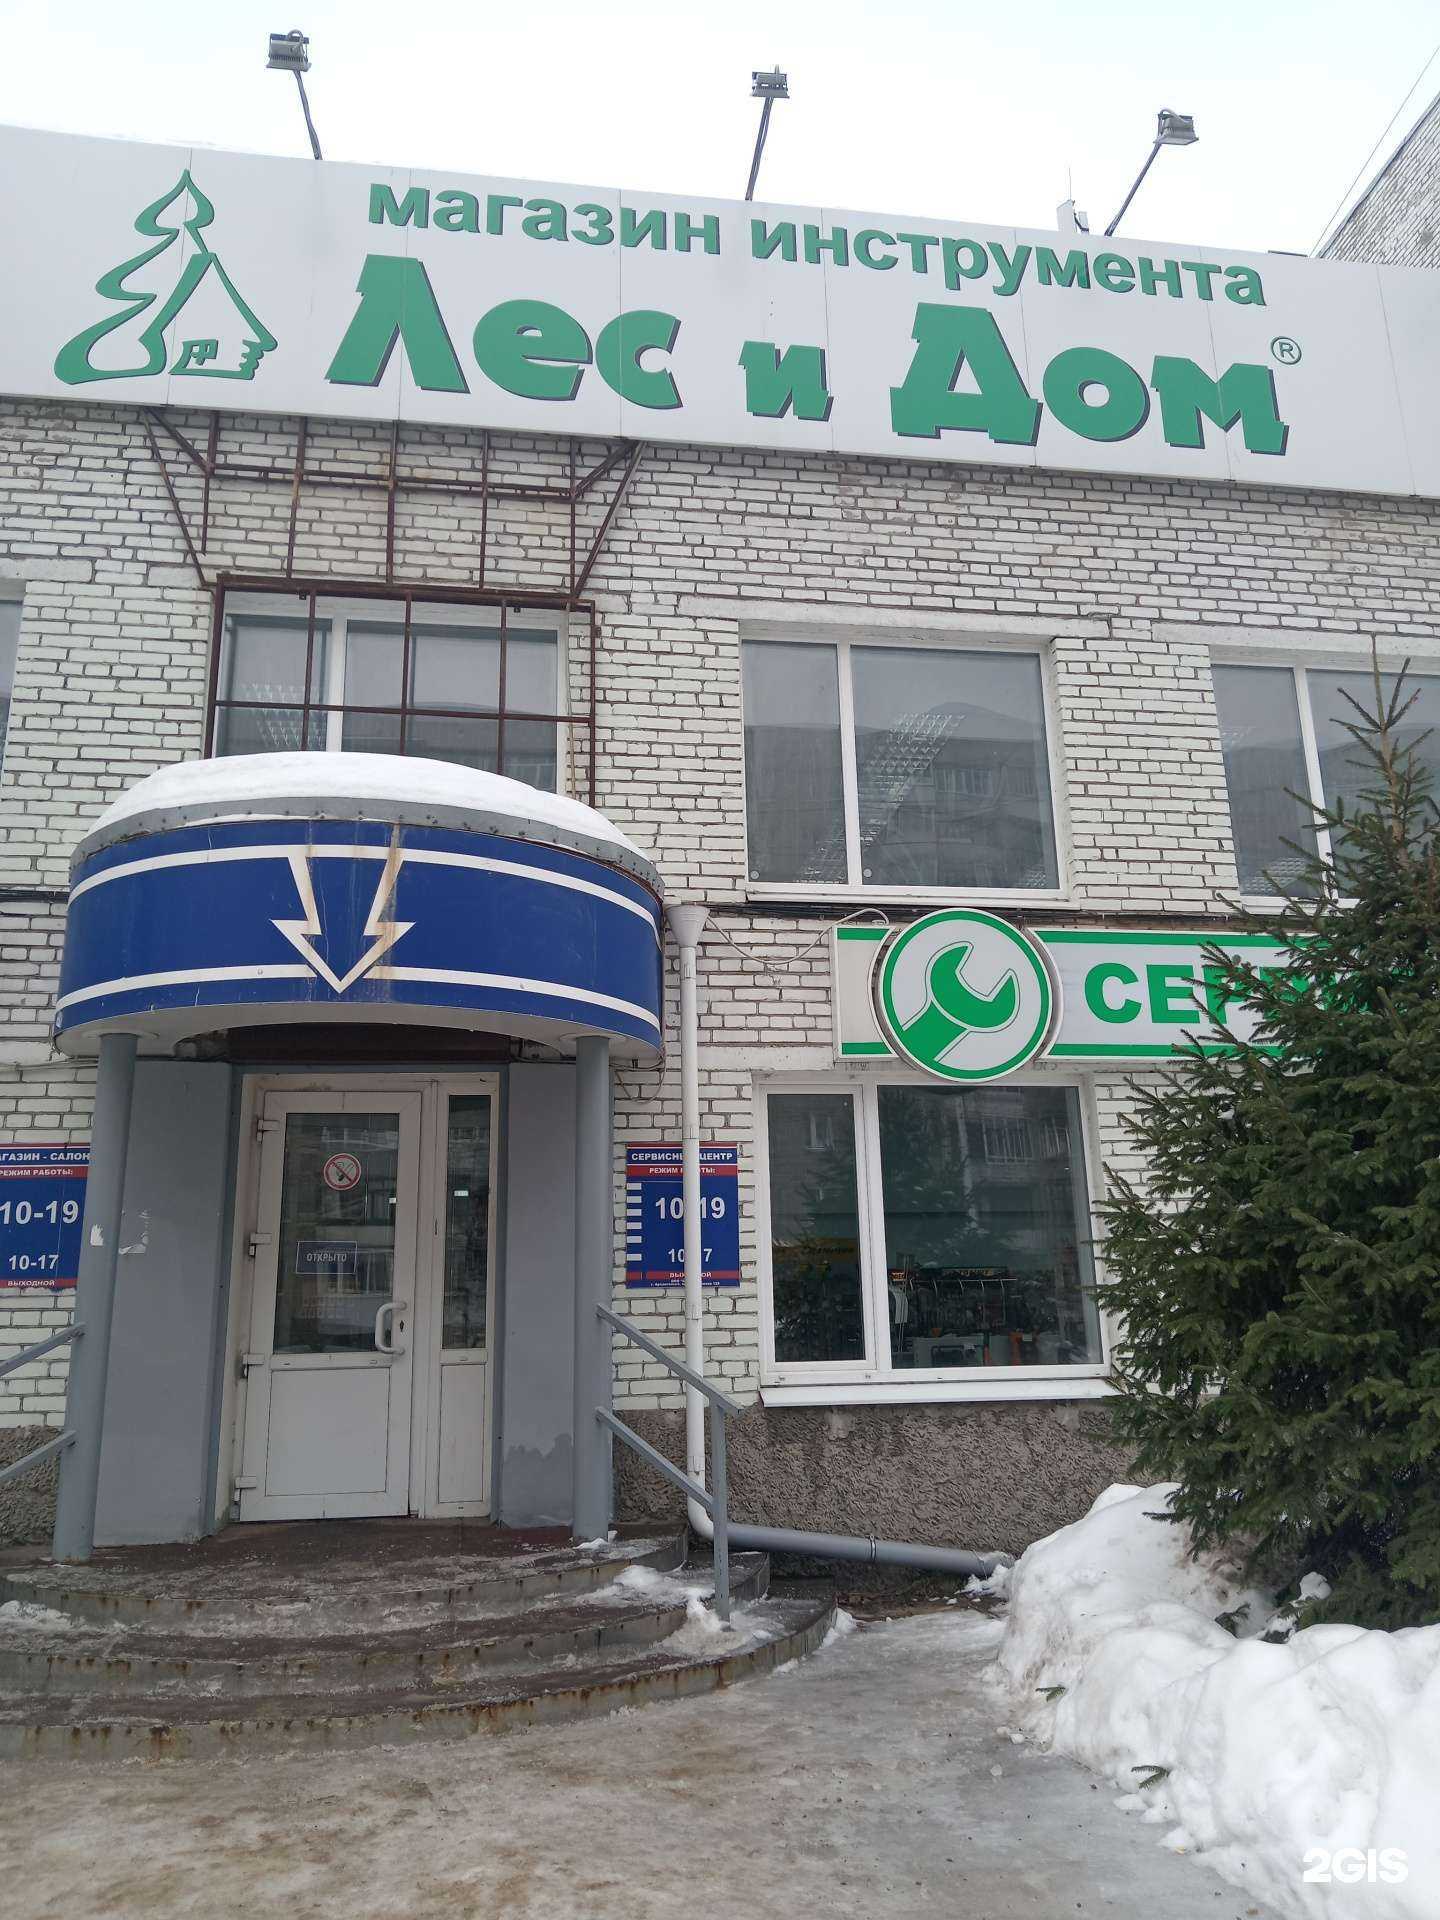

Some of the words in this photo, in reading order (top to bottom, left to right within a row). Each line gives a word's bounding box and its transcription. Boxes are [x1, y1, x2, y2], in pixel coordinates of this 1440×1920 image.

[369, 182, 720, 255] магазин
[750, 217, 1267, 306] инструмента
[325, 253, 684, 410] Лес
[738, 340, 833, 421] и
[890, 302, 1290, 456] Дом
[50, 1152, 90, 1161] САЛОН
[631, 1152, 684, 1161] СЕРВИСН
[700, 1152, 733, 1161] ЦЕНТР
[33, 1168, 73, 1176] РАБОТЫ:
[0, 1200, 79, 1225] 10-19
[8, 1254, 59, 1270] 10-17
[306, 1252, 347, 1262] ОТКРЫТО
[8, 1279, 55, 1287] ВЫХОДНОЙ
